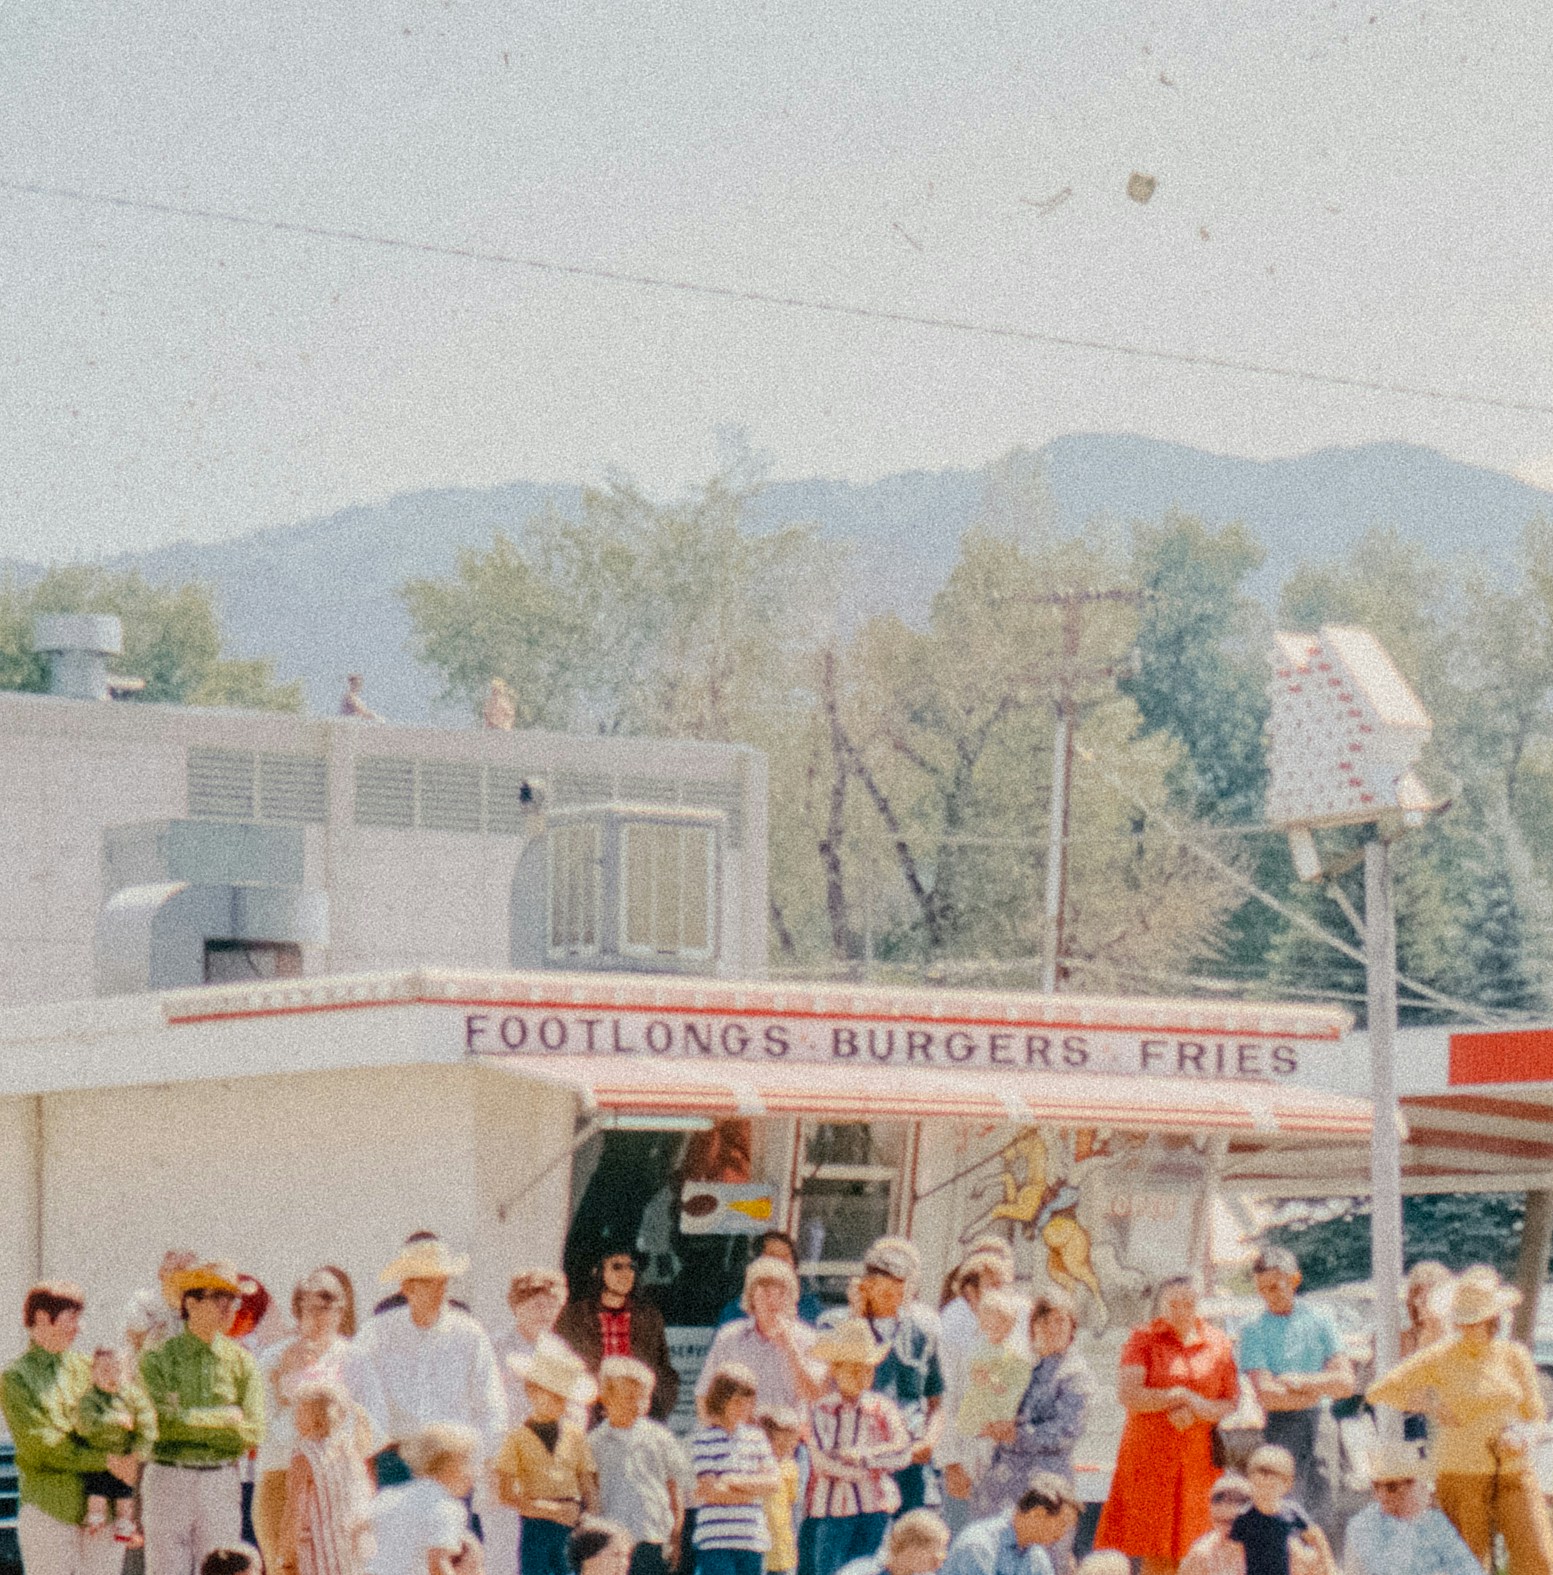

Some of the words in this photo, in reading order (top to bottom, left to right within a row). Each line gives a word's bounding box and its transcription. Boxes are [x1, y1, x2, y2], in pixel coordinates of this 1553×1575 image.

[465, 1012, 792, 1060] FOOTLONGS
[831, 1025, 1091, 1068] BURGERS
[1140, 1038, 1299, 1076] FRIES
